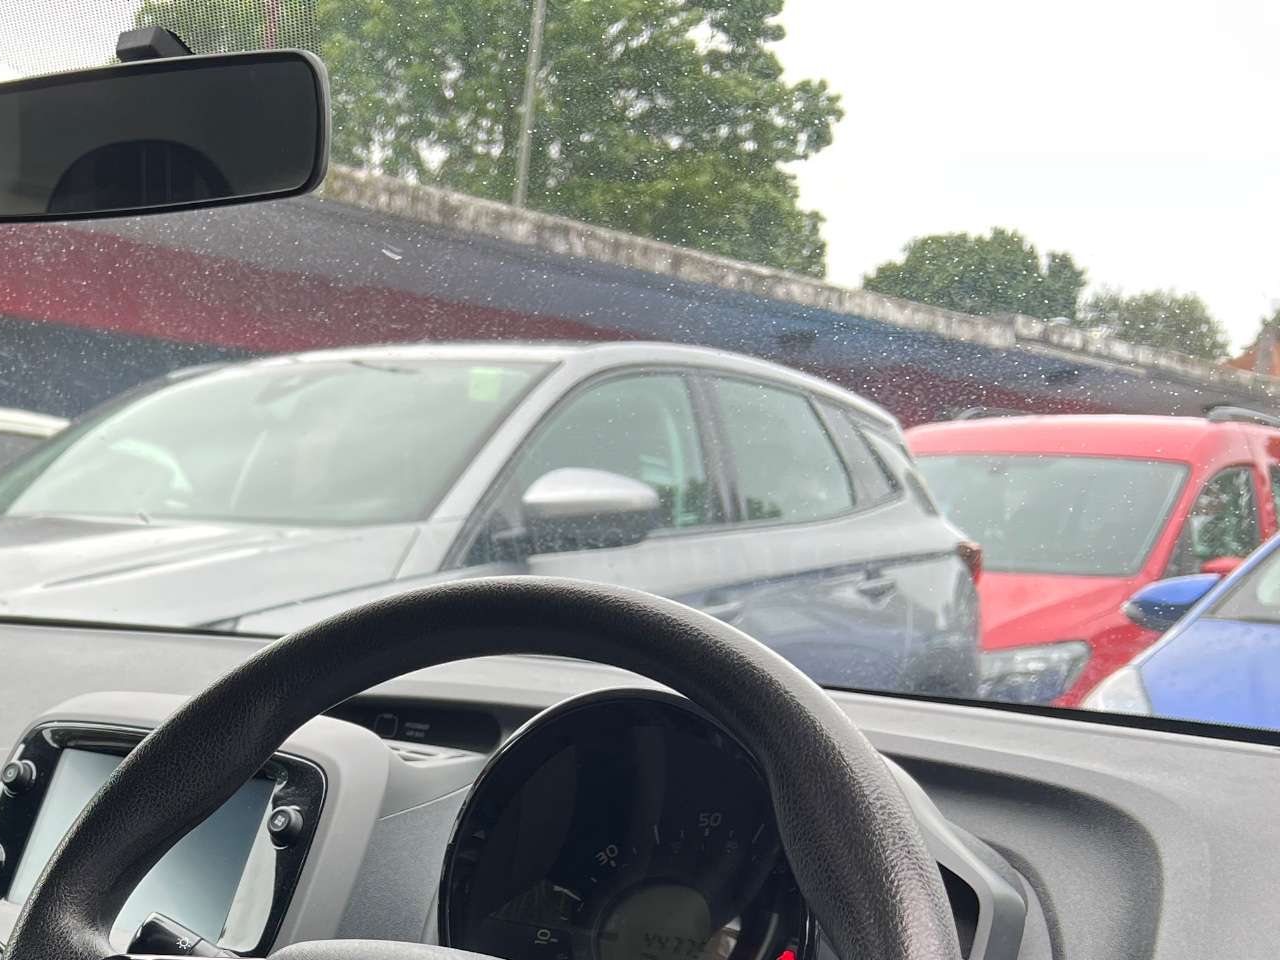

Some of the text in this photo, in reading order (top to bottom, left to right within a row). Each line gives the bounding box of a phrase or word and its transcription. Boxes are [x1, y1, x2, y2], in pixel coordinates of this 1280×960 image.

[698, 812, 723, 828] 50
[594, 844, 619, 866] 30
[534, 928, 552, 945] 10
